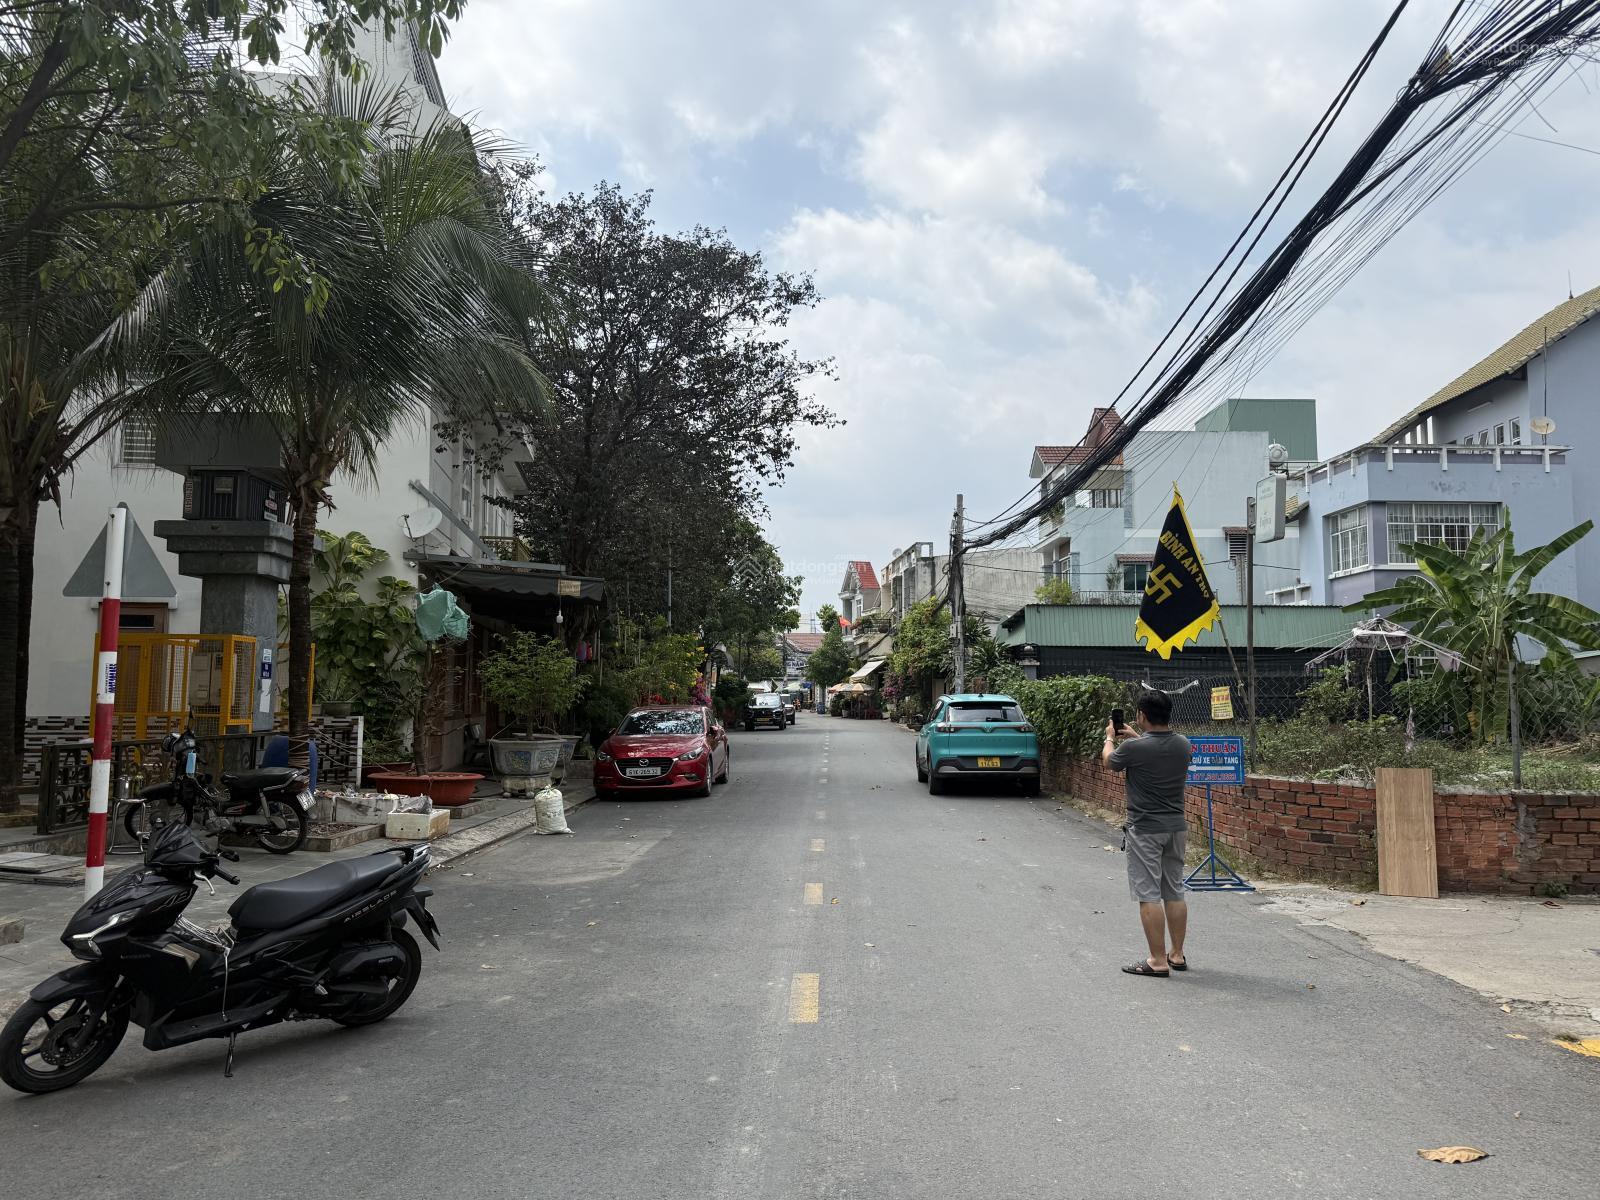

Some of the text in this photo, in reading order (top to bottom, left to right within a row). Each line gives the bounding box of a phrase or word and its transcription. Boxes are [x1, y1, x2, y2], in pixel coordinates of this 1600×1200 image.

[1160, 530, 1188, 560] BÌNH
[1181, 556, 1200, 575] AN
[1202, 756, 1211, 764] XE
[1224, 756, 1239, 764] TANG
